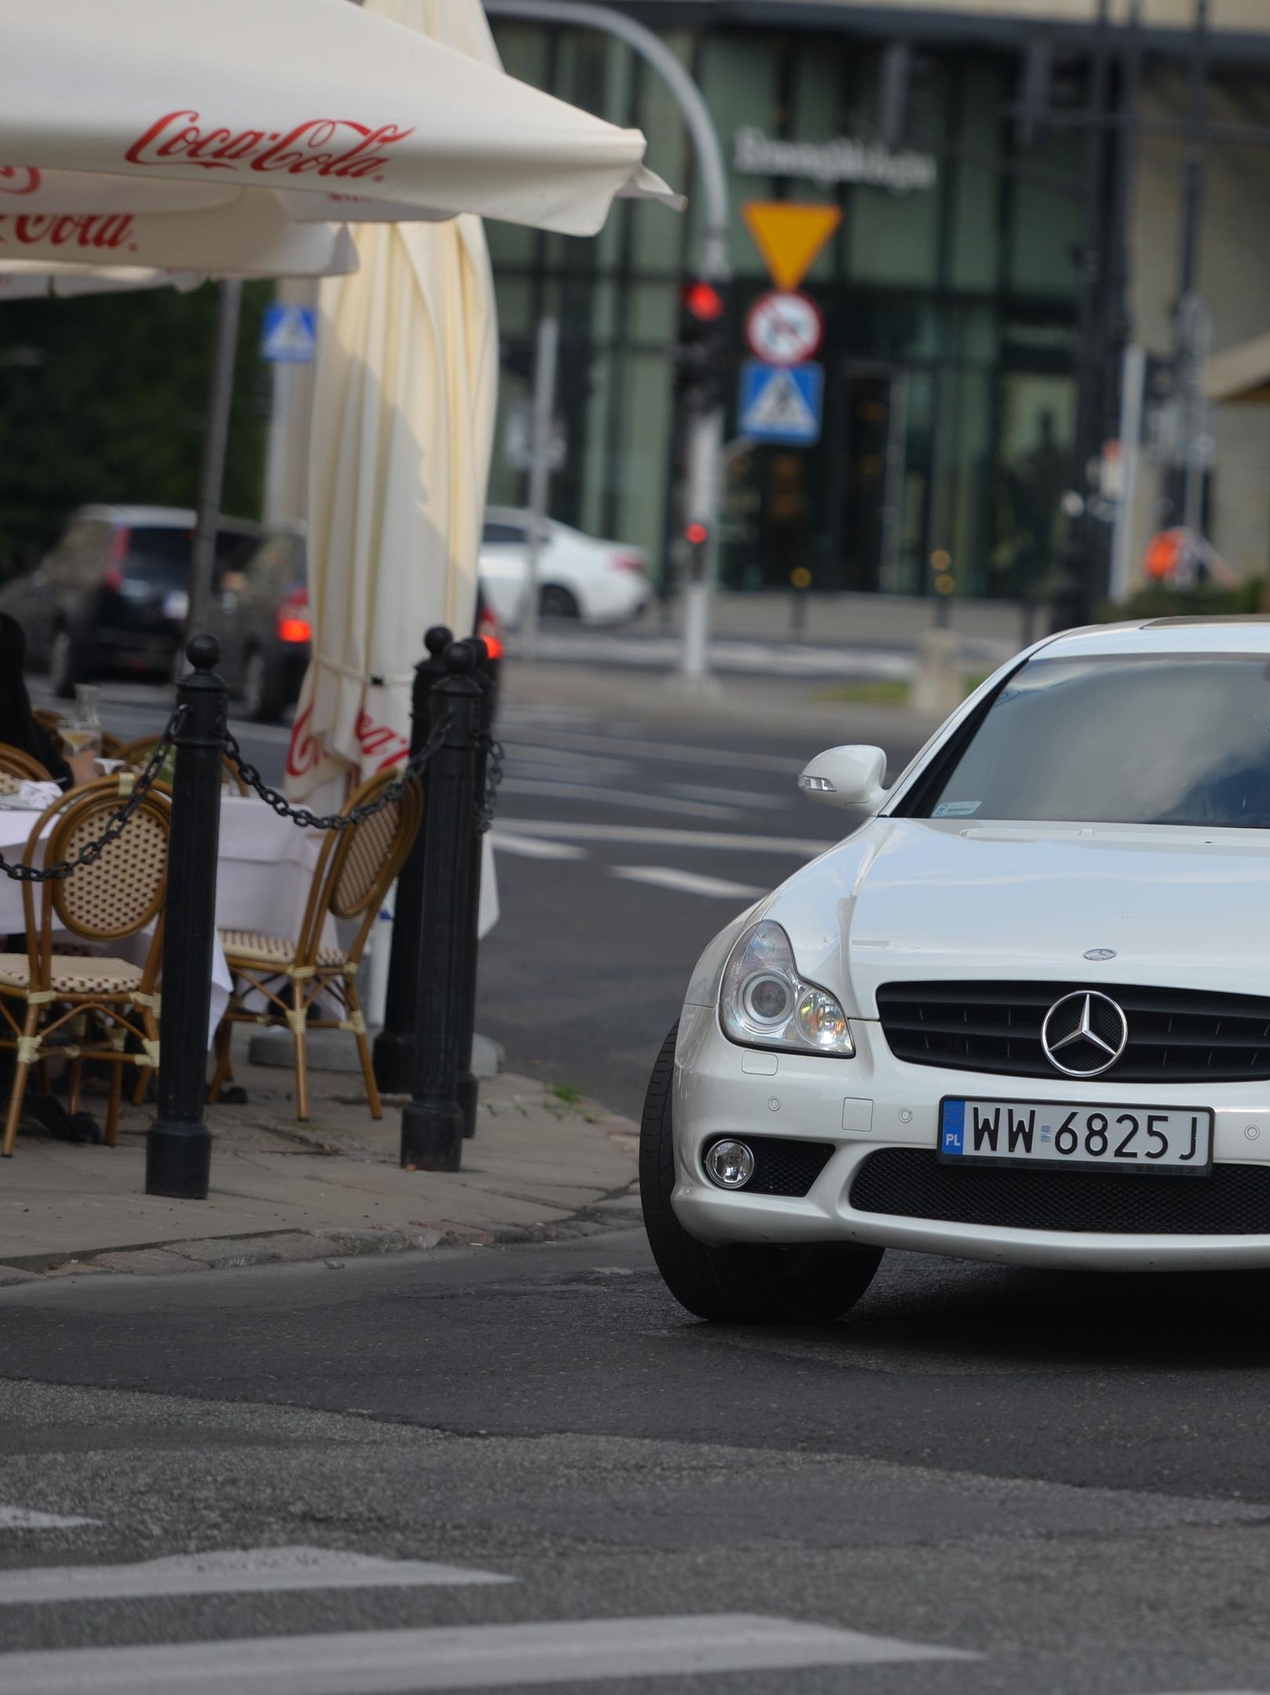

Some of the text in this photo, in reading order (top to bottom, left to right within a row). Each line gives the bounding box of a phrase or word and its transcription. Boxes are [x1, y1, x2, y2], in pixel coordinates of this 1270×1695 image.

[945, 1134, 961, 1147] PL
[972, 1106, 1198, 1161] WW 6825J
